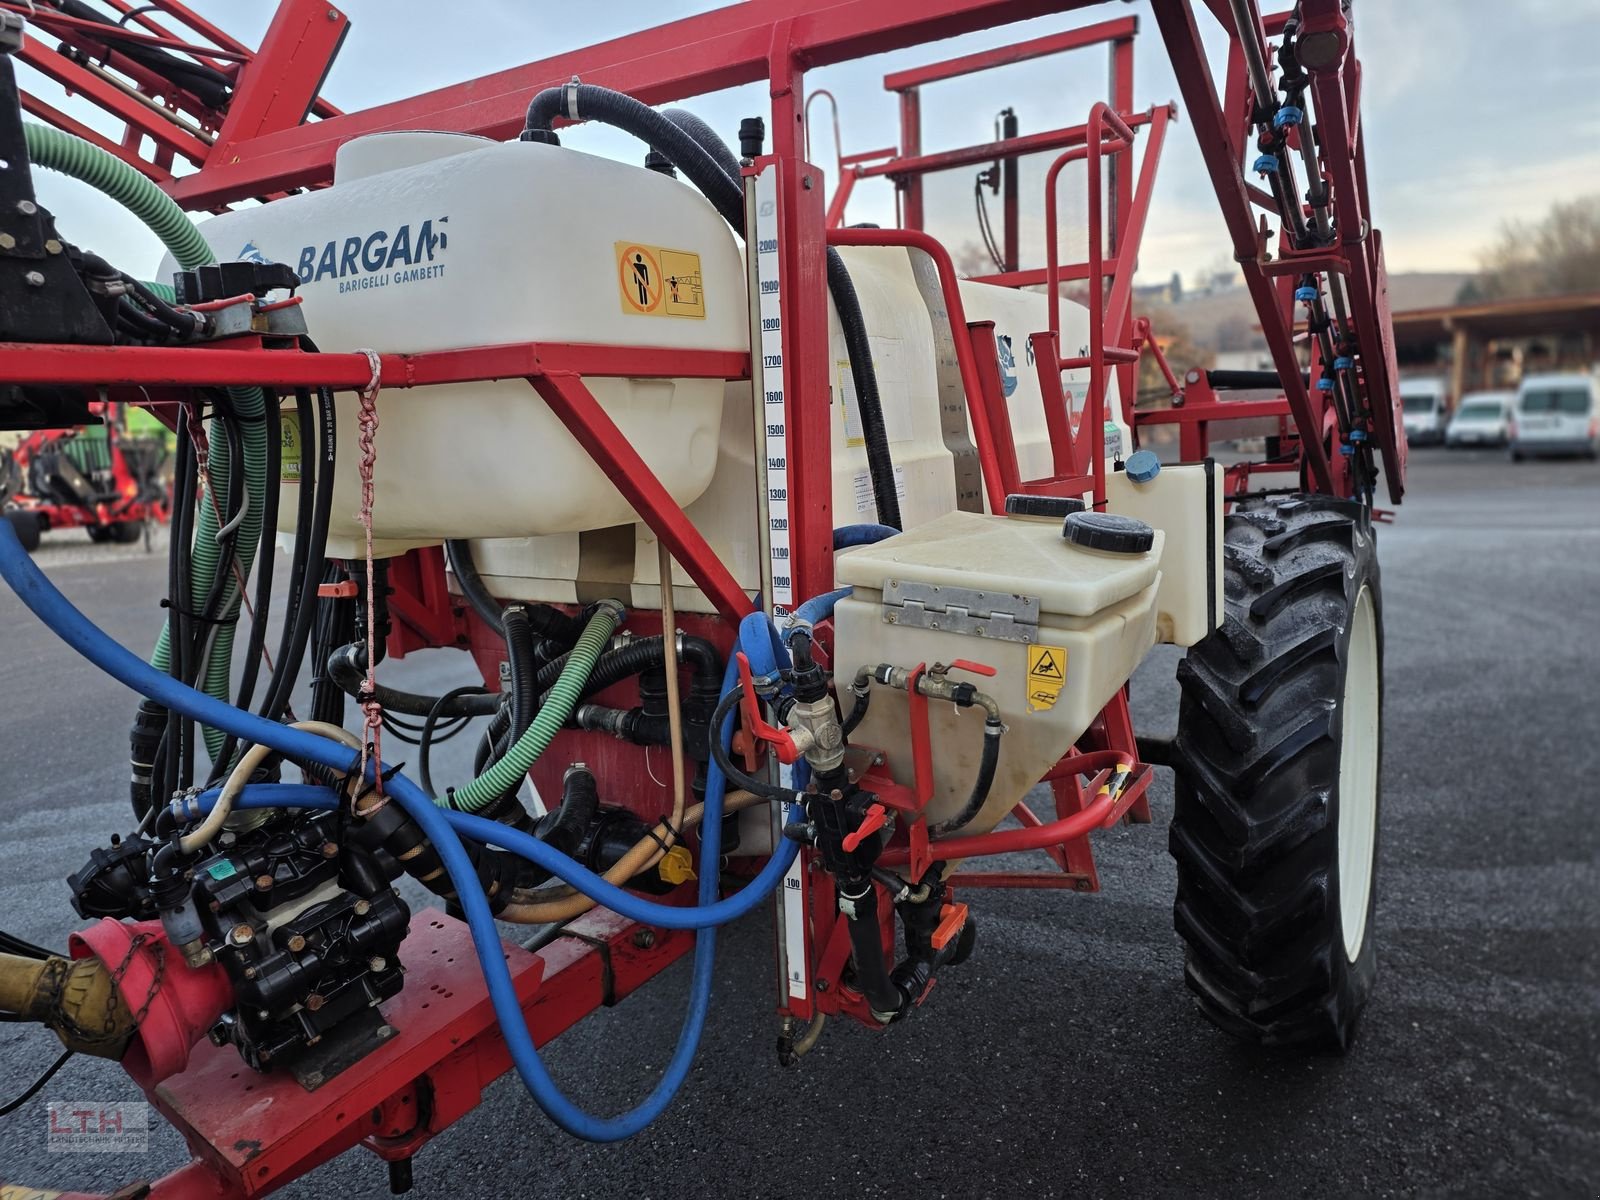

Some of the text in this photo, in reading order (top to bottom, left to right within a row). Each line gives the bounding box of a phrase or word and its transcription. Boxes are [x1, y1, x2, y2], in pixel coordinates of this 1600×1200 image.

[759, 240, 777, 251] 2000
[339, 275, 390, 294] BARIGELLI
[761, 280, 779, 292] 1900
[762, 318, 780, 329] 1800
[764, 355, 782, 366] 1700
[765, 391, 783, 402] 1600
[325, 410, 333, 420] BAR
[767, 424, 784, 435] 1500
[768, 458, 786, 468] 1400
[769, 489, 787, 499] 1300
[770, 519, 788, 529] 1200
[772, 547, 789, 557] 1100
[773, 576, 791, 586] 1000
[786, 877, 800, 888] 100
